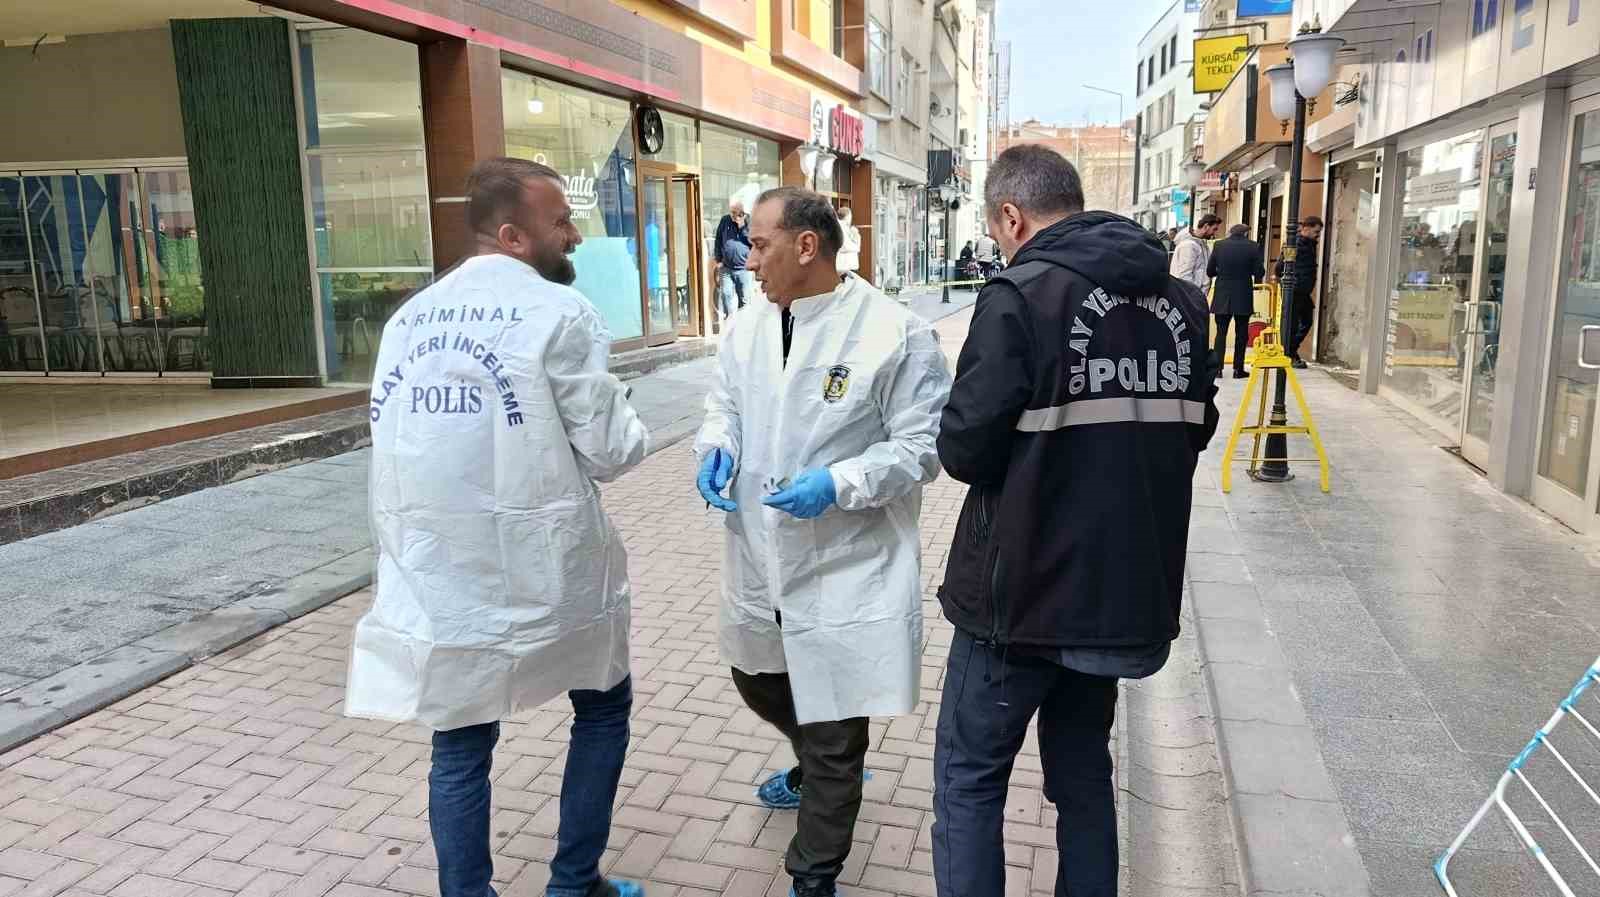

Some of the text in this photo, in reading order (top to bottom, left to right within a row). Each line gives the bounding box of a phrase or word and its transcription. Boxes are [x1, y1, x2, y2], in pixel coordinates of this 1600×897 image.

[1206, 64, 1235, 75] TEKEL
[1069, 316, 1093, 395] OLAY
[1082, 287, 1130, 317] YE
[370, 331, 524, 426] OLAY YERİ İNCELEME
[1088, 349, 1178, 393] POLİS
[411, 379, 483, 414] POLİS
